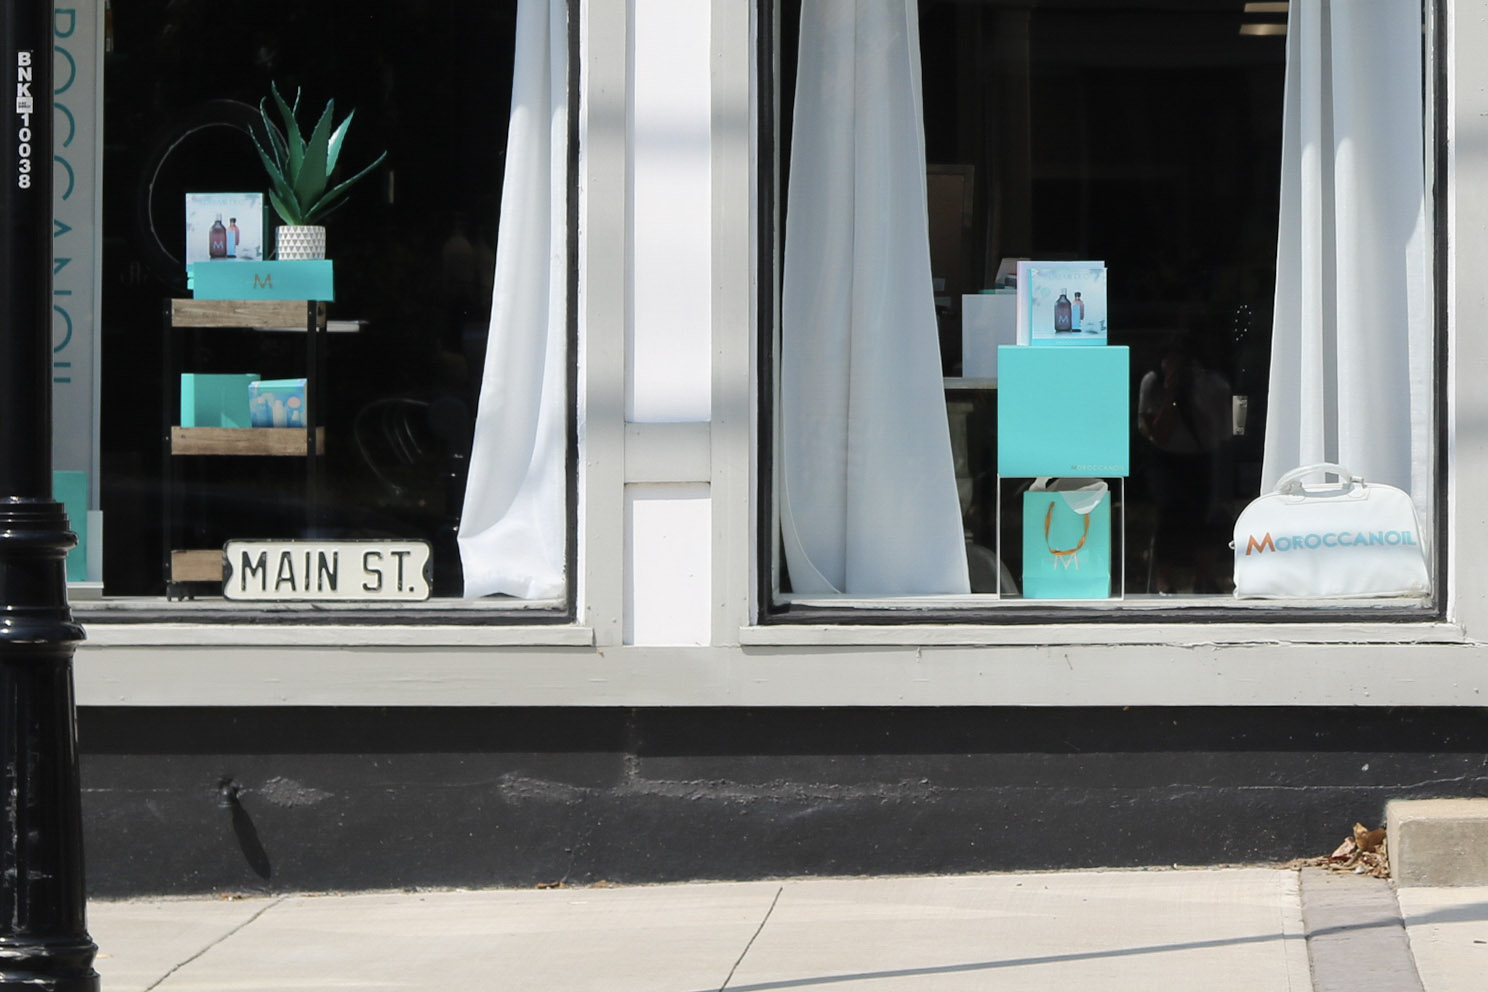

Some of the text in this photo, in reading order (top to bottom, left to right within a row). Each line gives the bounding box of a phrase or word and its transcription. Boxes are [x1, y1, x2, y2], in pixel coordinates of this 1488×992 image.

[17, 51, 33, 97] BNK
[18, 112, 32, 189] 10038
[253, 273, 273, 289] M
[1245, 520, 1417, 556] MOROCCANOIL
[240, 550, 415, 592] MAIN ST.
